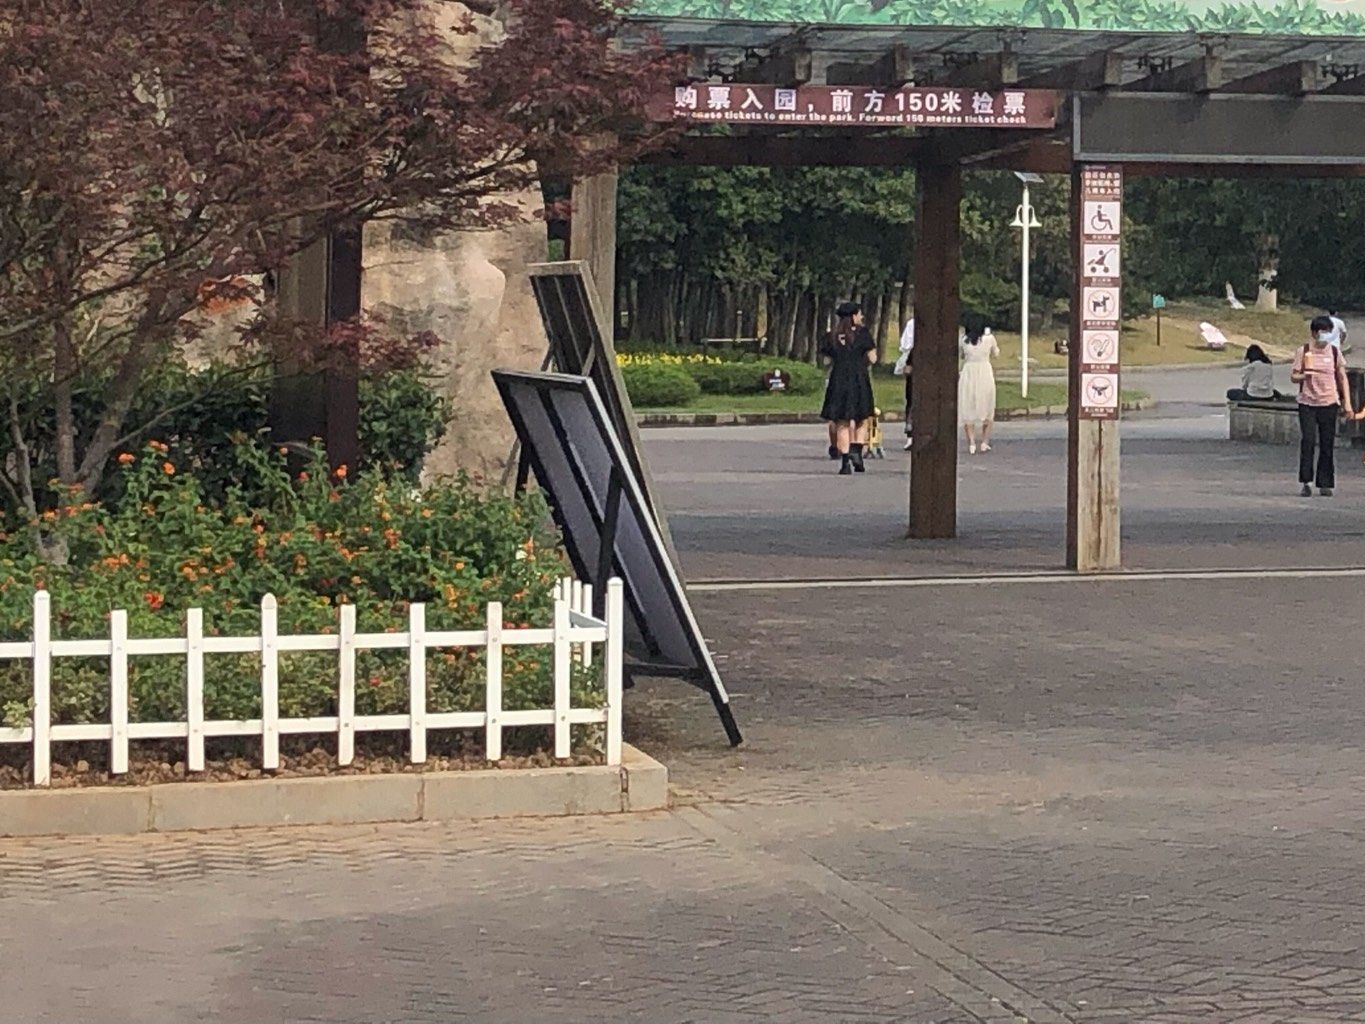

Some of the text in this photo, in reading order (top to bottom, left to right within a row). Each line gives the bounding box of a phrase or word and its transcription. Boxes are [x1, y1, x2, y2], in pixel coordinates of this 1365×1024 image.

[674, 86, 1026, 115] 购票入园，前方150米检票
[724, 110, 763, 120] tickets
[764, 111, 775, 120] to
[778, 112, 806, 121] enter
[808, 112, 827, 121] the
[906, 114, 923, 123] 150
[926, 115, 962, 124] meters
[964, 115, 995, 124] ticket
[996, 116, 1027, 125] check
